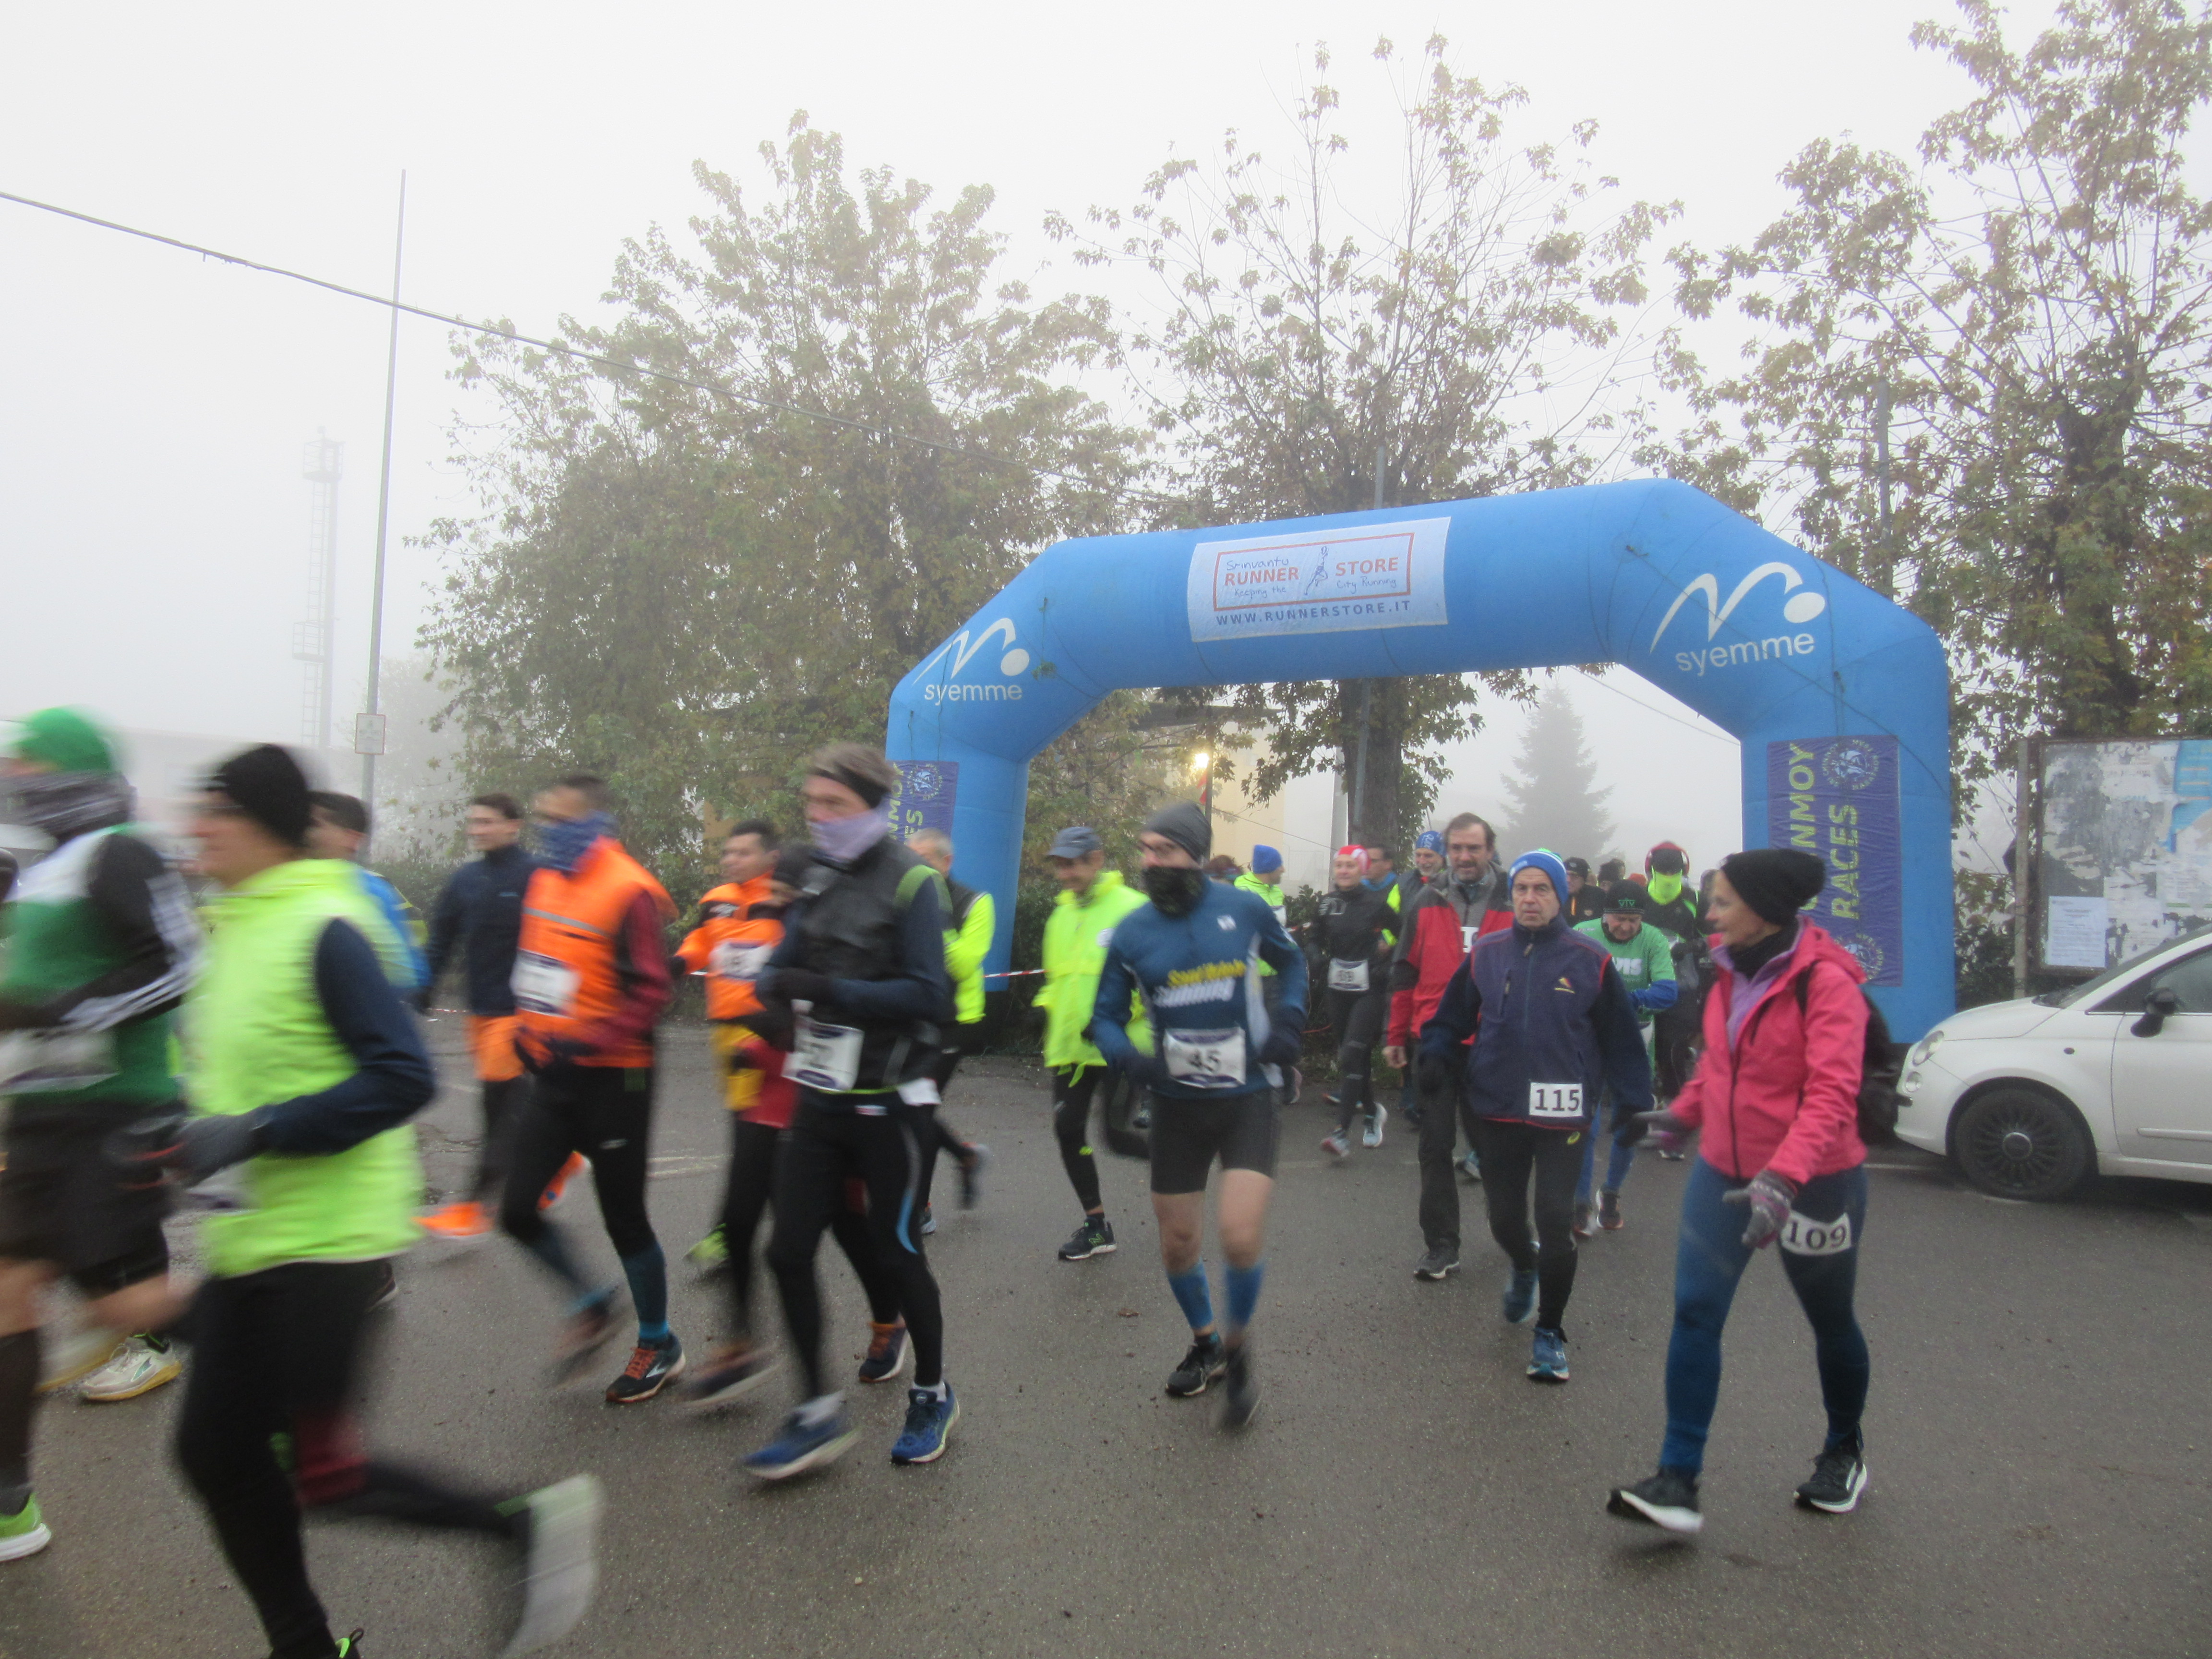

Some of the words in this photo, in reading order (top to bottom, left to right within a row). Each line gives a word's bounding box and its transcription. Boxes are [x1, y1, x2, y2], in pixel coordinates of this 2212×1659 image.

[1225, 566, 1300, 587] RUNNER
[1335, 557, 1399, 577] STORE
[1337, 579, 1357, 594] City
[1362, 576, 1397, 589] Running
[1216, 600, 1411, 625] WWW.RUNNERSTORE.IT
[1675, 633, 1815, 677] syemme
[925, 684, 1023, 706] syemme
[1789, 743, 1817, 911] NMOY
[1829, 805, 1860, 919] RACES
[1535, 1088, 1580, 1112] 115
[1786, 1220, 1846, 1250] 109
